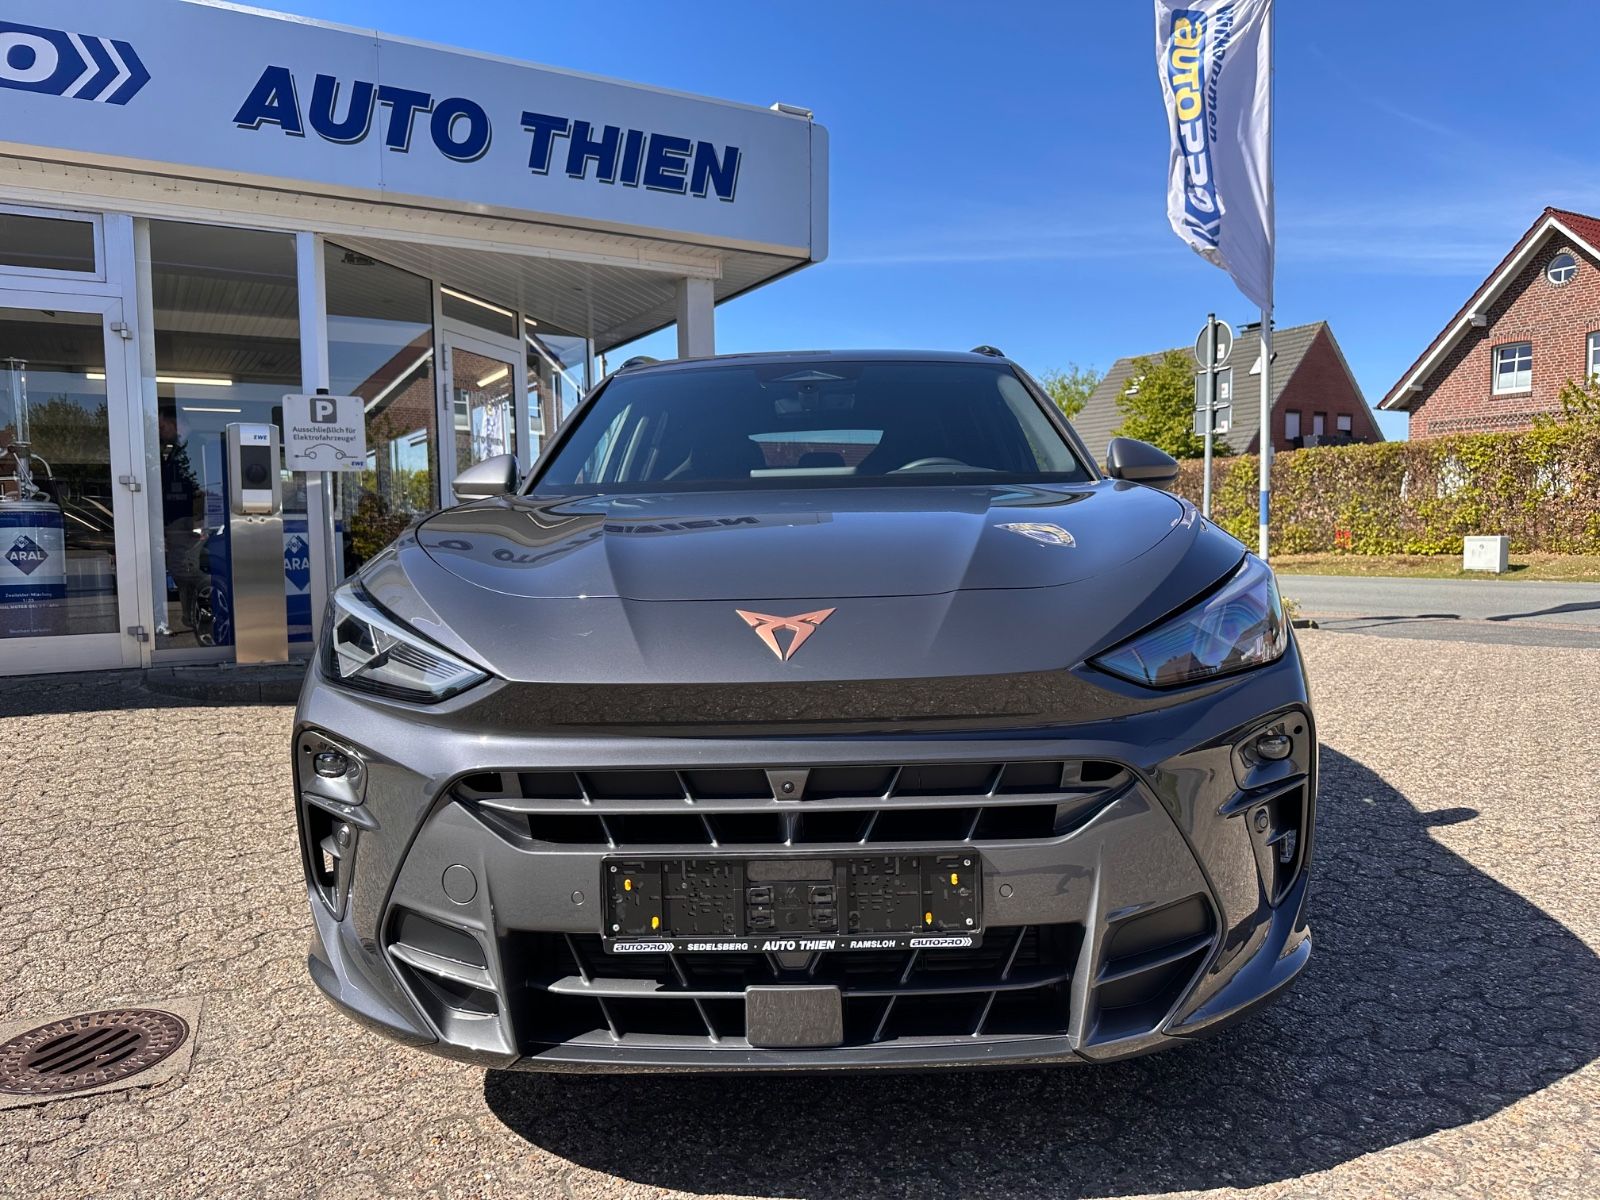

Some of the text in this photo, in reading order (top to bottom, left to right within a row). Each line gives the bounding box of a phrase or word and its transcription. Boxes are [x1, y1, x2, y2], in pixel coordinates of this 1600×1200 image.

[233, 65, 742, 203] AUTO THIEN
[315, 400, 334, 421] P
[292, 426, 344, 434] Ausschließlich
[10, 551, 44, 561] ARAL
[687, 943, 748, 951] SEDELSBERG
[762, 941, 796, 951] AUTO
[799, 940, 835, 950] THIEN
[850, 940, 896, 949] RAMSLOH
